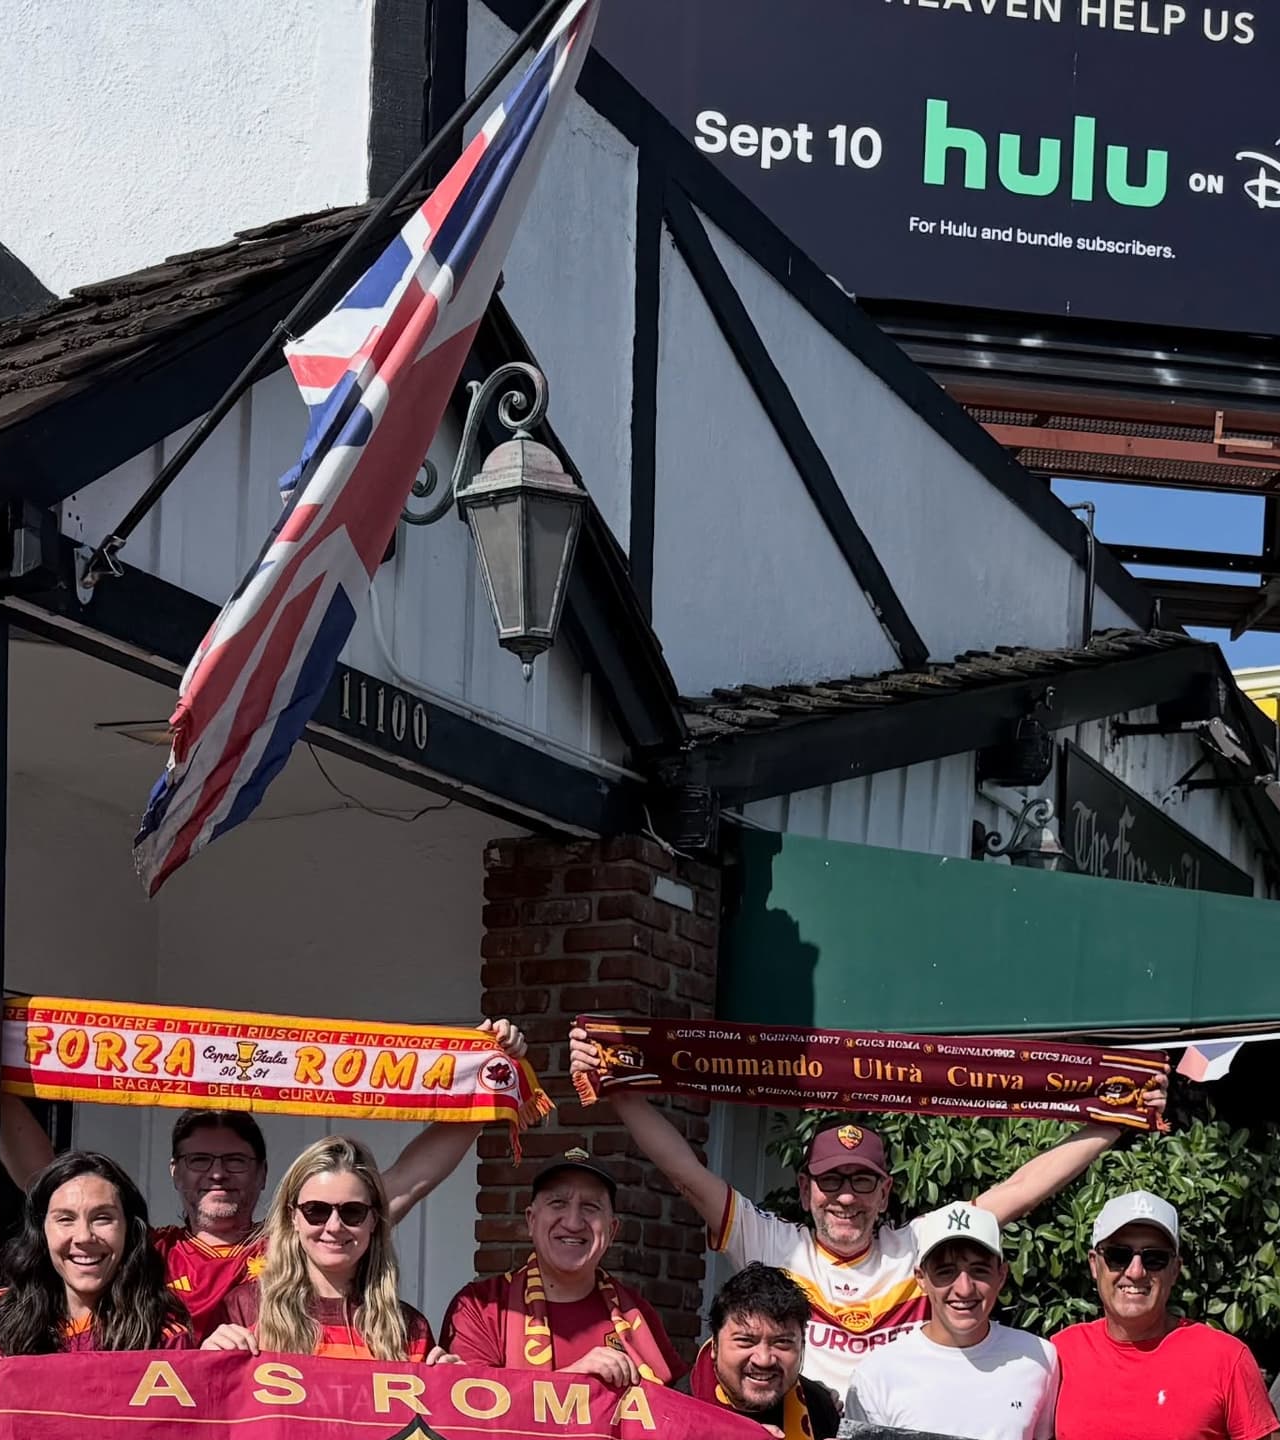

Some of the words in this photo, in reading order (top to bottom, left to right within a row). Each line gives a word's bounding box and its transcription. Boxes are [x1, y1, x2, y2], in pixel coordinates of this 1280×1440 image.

[1080, 0, 1186, 35] HELP
[1202, 8, 1255, 44] US
[693, 109, 813, 170] Sept
[827, 123, 883, 170] 10
[923, 98, 1168, 208] hulu
[1188, 172, 1224, 194] ON
[909, 216, 936, 233] For
[939, 219, 977, 239] Hulu
[980, 223, 1012, 242] and
[1016, 228, 1072, 249] bundle
[1076, 234, 1176, 259] subscribers.
[340, 671, 428, 750] 11100
[84, 1013, 157, 1032] DOVERE
[164, 1020, 181, 1032] DI
[247, 1026, 333, 1043] RIUSCIRCI
[383, 1036, 443, 1050] ONORE
[448, 1039, 465, 1050] DI
[708, 1030, 741, 1040] ROMA
[855, 1038, 885, 1048] CUCS
[887, 1040, 920, 1051] ROMA
[1031, 1051, 1060, 1062] CUCS
[1061, 1054, 1093, 1065] ROMA
[24, 1026, 196, 1078] FORZA
[294, 1046, 457, 1090] ROMA
[203, 1046, 238, 1063] Coppa
[252, 1050, 289, 1065] Italia
[220, 1066, 237, 1077] 90
[253, 1068, 270, 1079] 91
[672, 1050, 824, 1078] Commando
[853, 1057, 923, 1084] Ultrà
[947, 1066, 1024, 1090] Curva
[1046, 1072, 1095, 1093] Sud
[112, 1077, 191, 1093] RAGAZZI
[208, 1084, 262, 1097] DELLA
[278, 1088, 336, 1103] CURVA
[352, 1094, 386, 1105] SUD
[880, 1094, 912, 1104] ROMA
[1049, 1102, 1080, 1112] ROMA
[371, 1372, 657, 1430] ROMA
